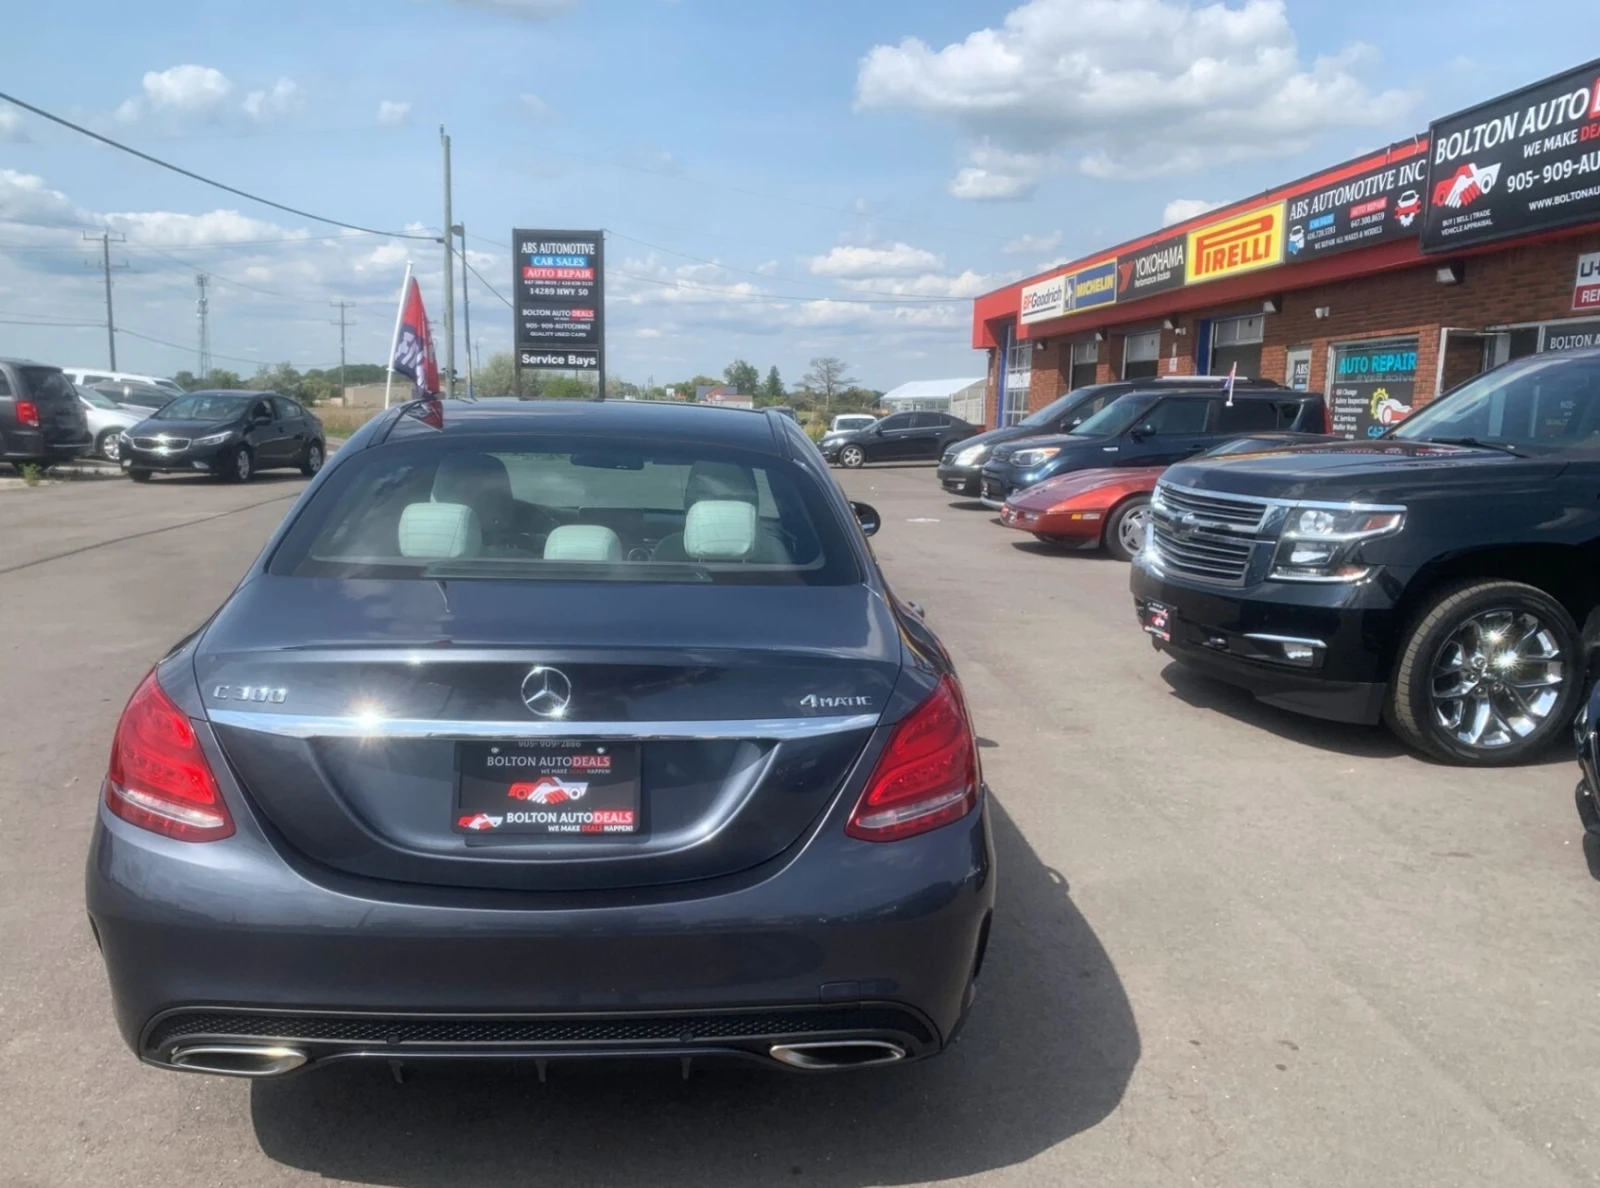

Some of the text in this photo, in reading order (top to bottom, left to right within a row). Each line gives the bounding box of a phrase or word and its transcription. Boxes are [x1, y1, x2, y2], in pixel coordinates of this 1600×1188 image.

[1435, 111, 1520, 165] BOLTON
[1524, 140, 1541, 158] WE
[1543, 128, 1578, 152] MAKE
[1289, 159, 1426, 221] ABS AUTOMOTIVE INC
[1473, 209, 1491, 219] TRADE
[1441, 219, 1493, 236] VEHICLE APPRAISAL
[521, 242, 595, 254] ABS AUTOMOTIVE
[1194, 214, 1274, 276] PIRELLI
[534, 258, 584, 266] CAR SALES
[1135, 244, 1184, 278] YOKOHAMA
[527, 269, 592, 278] AUTO REPAIR
[1076, 274, 1114, 297] MICHELIN
[1550, 334, 1592, 349] BOLTON
[522, 354, 596, 367] Service Bays
[1339, 352, 1417, 374] AUTO REPAIR
[214, 686, 287, 704] C 300
[800, 694, 872, 707] 4MATIC
[487, 756, 536, 766] BOLTON
[506, 812, 557, 823] BOLTON
